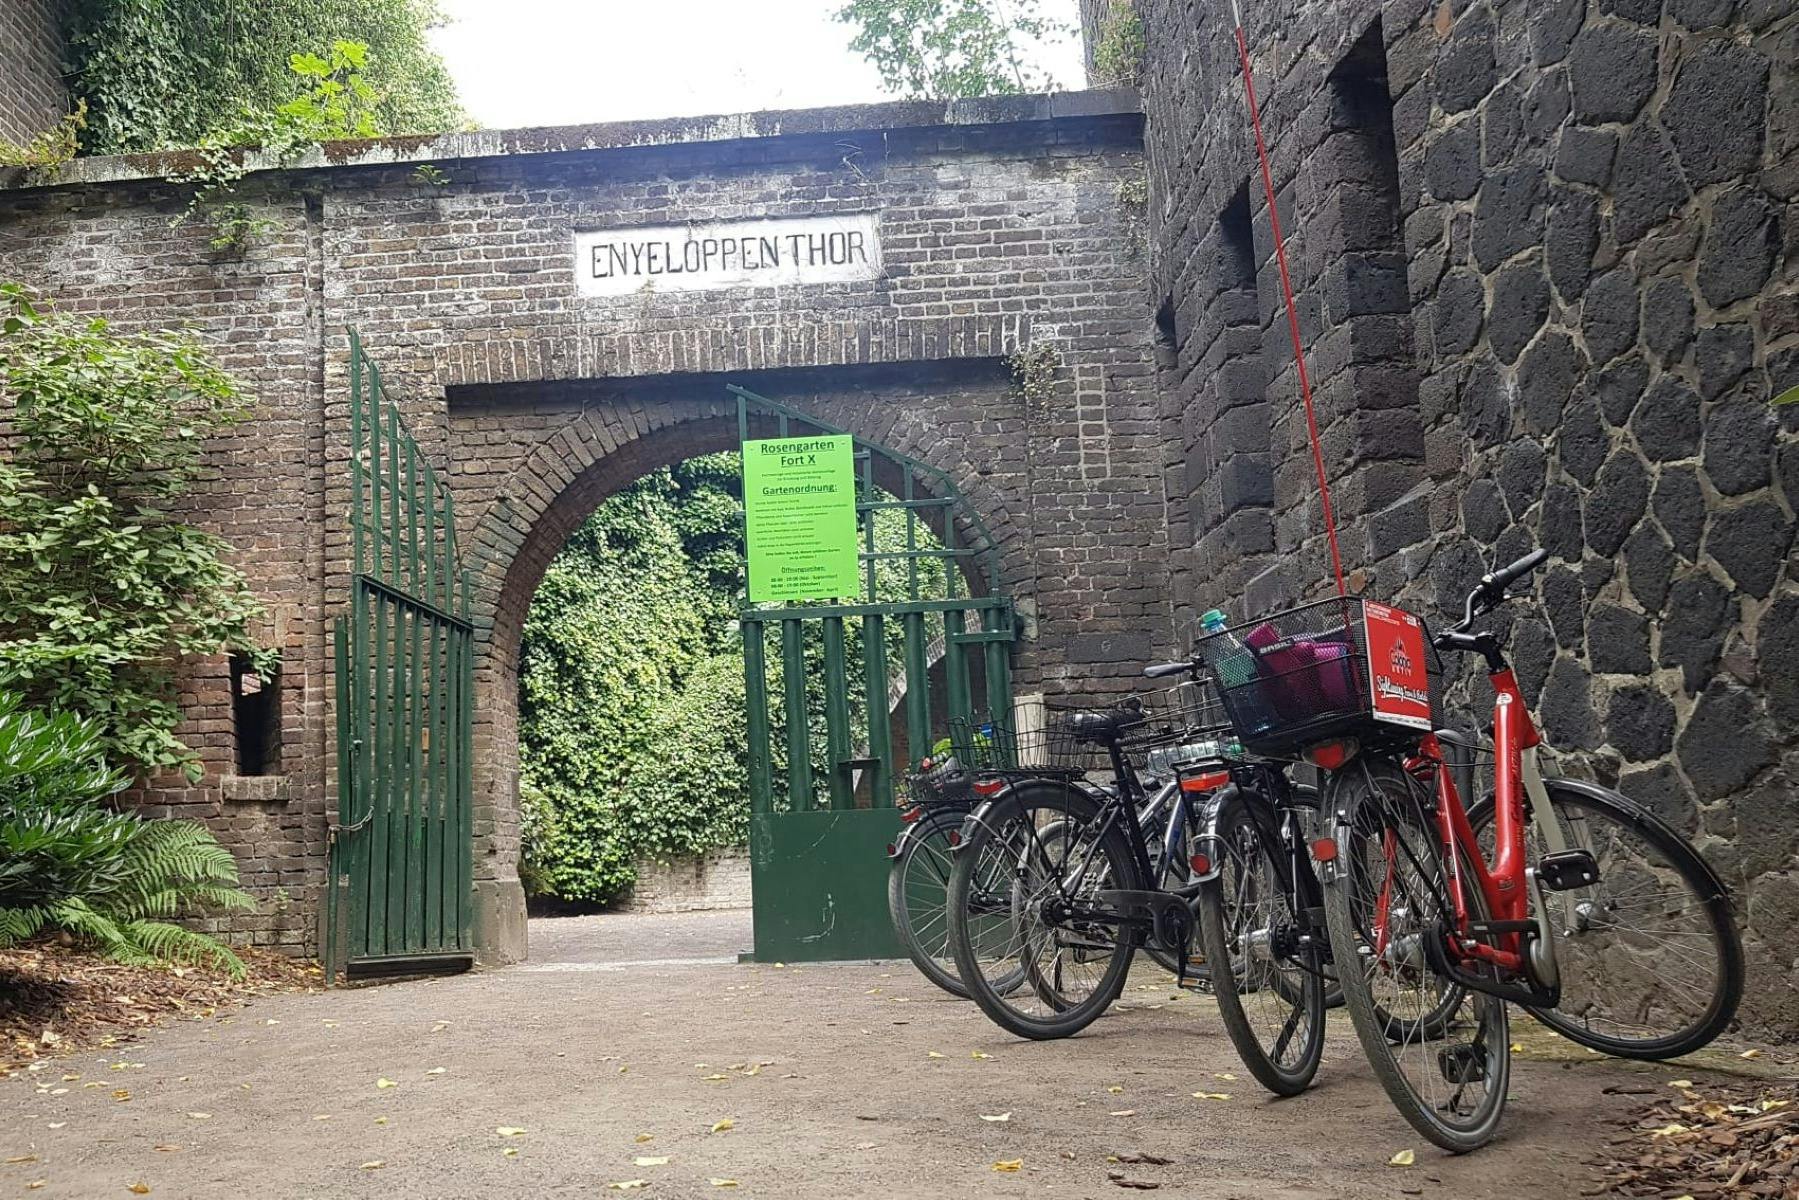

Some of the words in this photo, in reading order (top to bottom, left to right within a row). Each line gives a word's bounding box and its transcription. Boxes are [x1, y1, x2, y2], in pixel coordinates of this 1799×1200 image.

[786, 231, 868, 266] THOR
[761, 441, 835, 454] Rosengarten
[781, 455, 804, 466] Fort
[808, 454, 816, 464] X
[762, 484, 838, 495] Gartenordnung:
